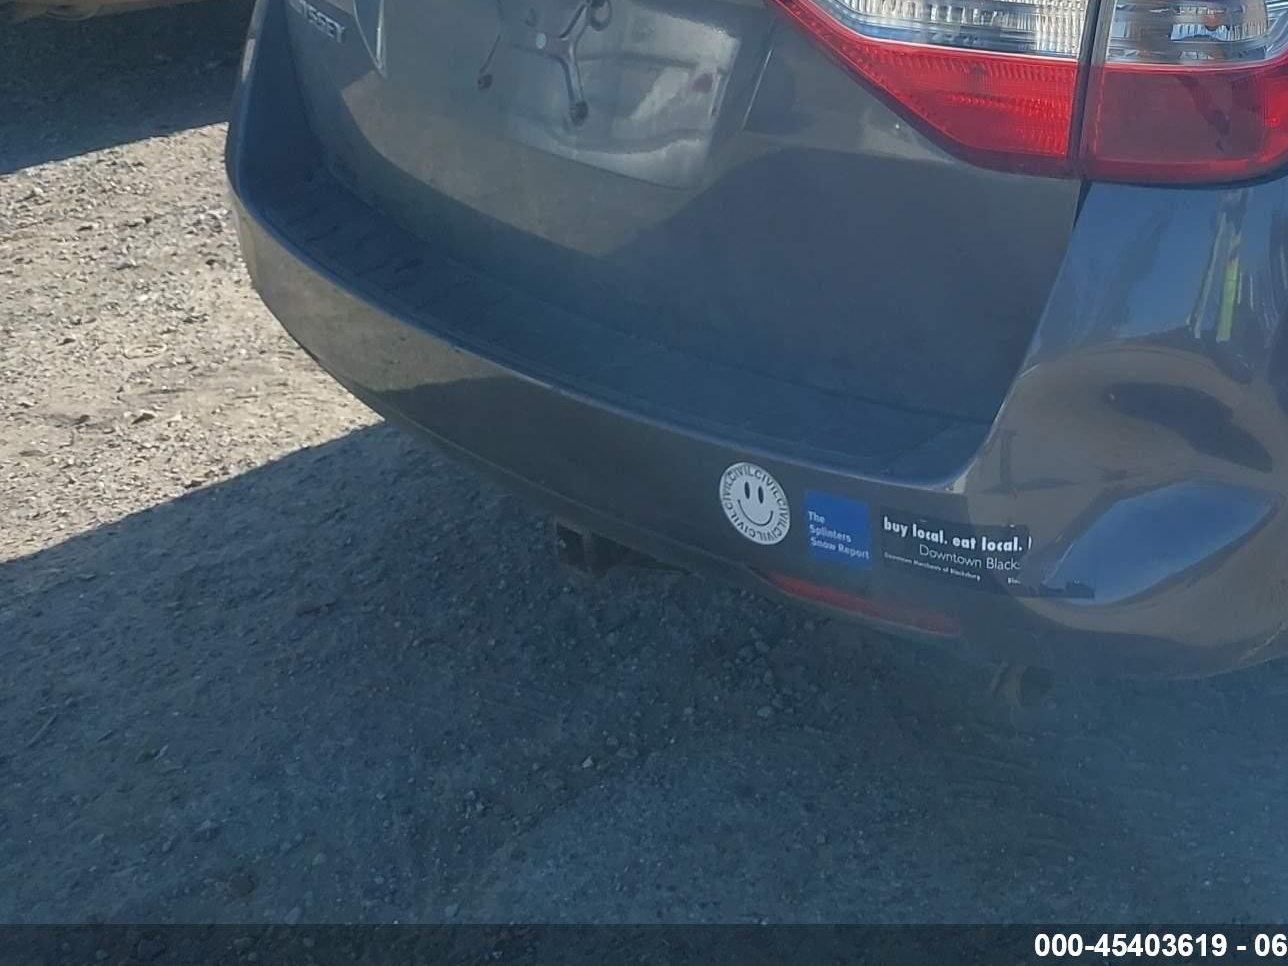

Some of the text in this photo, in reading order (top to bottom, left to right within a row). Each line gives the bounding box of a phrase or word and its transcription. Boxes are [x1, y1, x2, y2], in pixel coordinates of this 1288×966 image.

[808, 510, 825, 524] The
[883, 516, 908, 537] buy
[912, 523, 948, 545] local.
[953, 537, 977, 550] eat
[982, 536, 1023, 552] local.
[810, 536, 869, 560] Snow Report
[919, 543, 982, 568] Downtown
